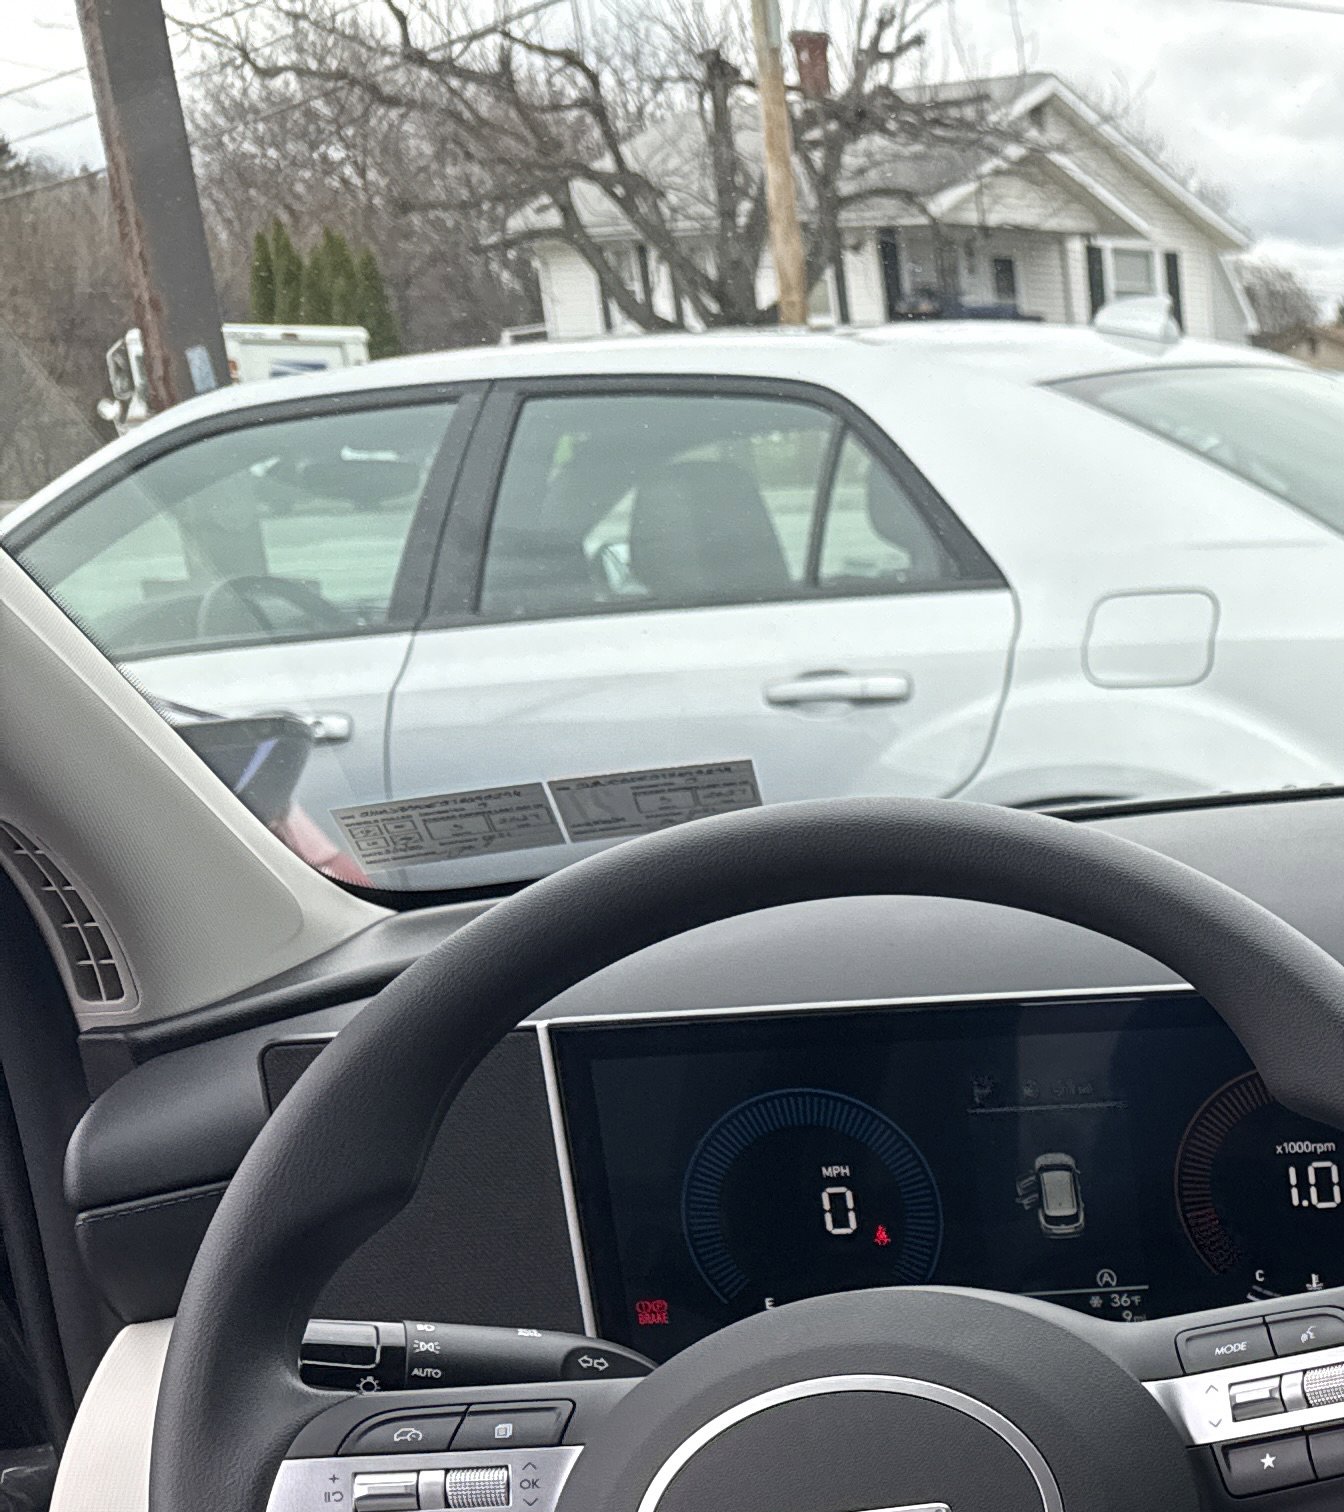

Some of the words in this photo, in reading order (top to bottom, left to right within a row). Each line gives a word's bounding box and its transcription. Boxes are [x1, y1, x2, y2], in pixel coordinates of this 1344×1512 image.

[1276, 1141, 1336, 1154] x1000rpm
[821, 1165, 850, 1178] MPH
[1289, 1161, 1341, 1209] 1.0
[821, 1187, 857, 1235] 0
[1255, 1270, 1265, 1281] C
[638, 1312, 669, 1325] BRAKE
[1214, 1341, 1248, 1355] MODE
[411, 1367, 441, 1378] AUTO
[519, 1479, 541, 1490] OK
